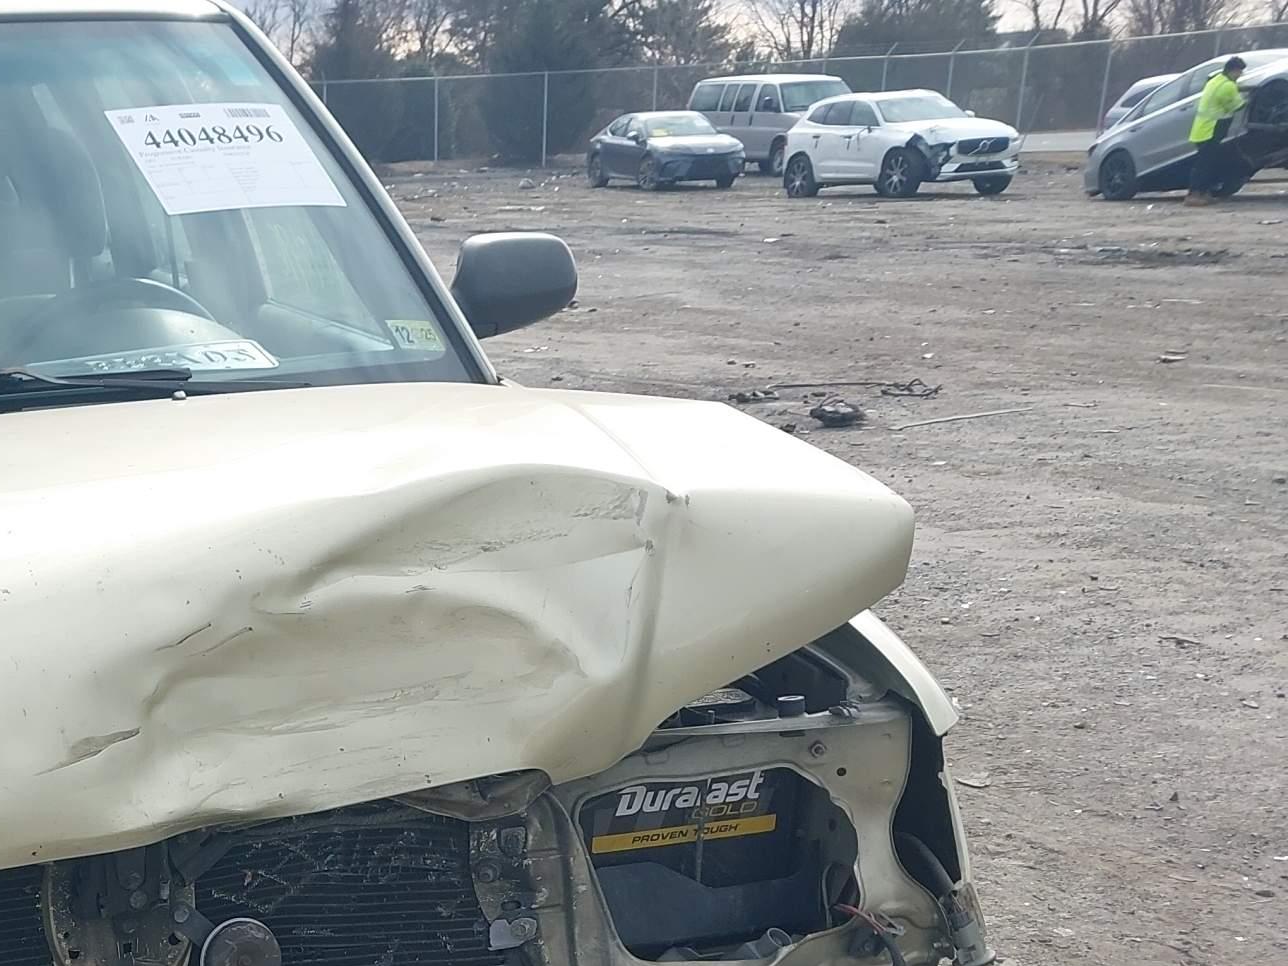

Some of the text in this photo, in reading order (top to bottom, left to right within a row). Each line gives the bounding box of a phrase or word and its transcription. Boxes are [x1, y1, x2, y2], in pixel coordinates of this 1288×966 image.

[144, 124, 284, 149] 44048496
[394, 326, 415, 343] 12
[631, 829, 688, 844] PROVEN
